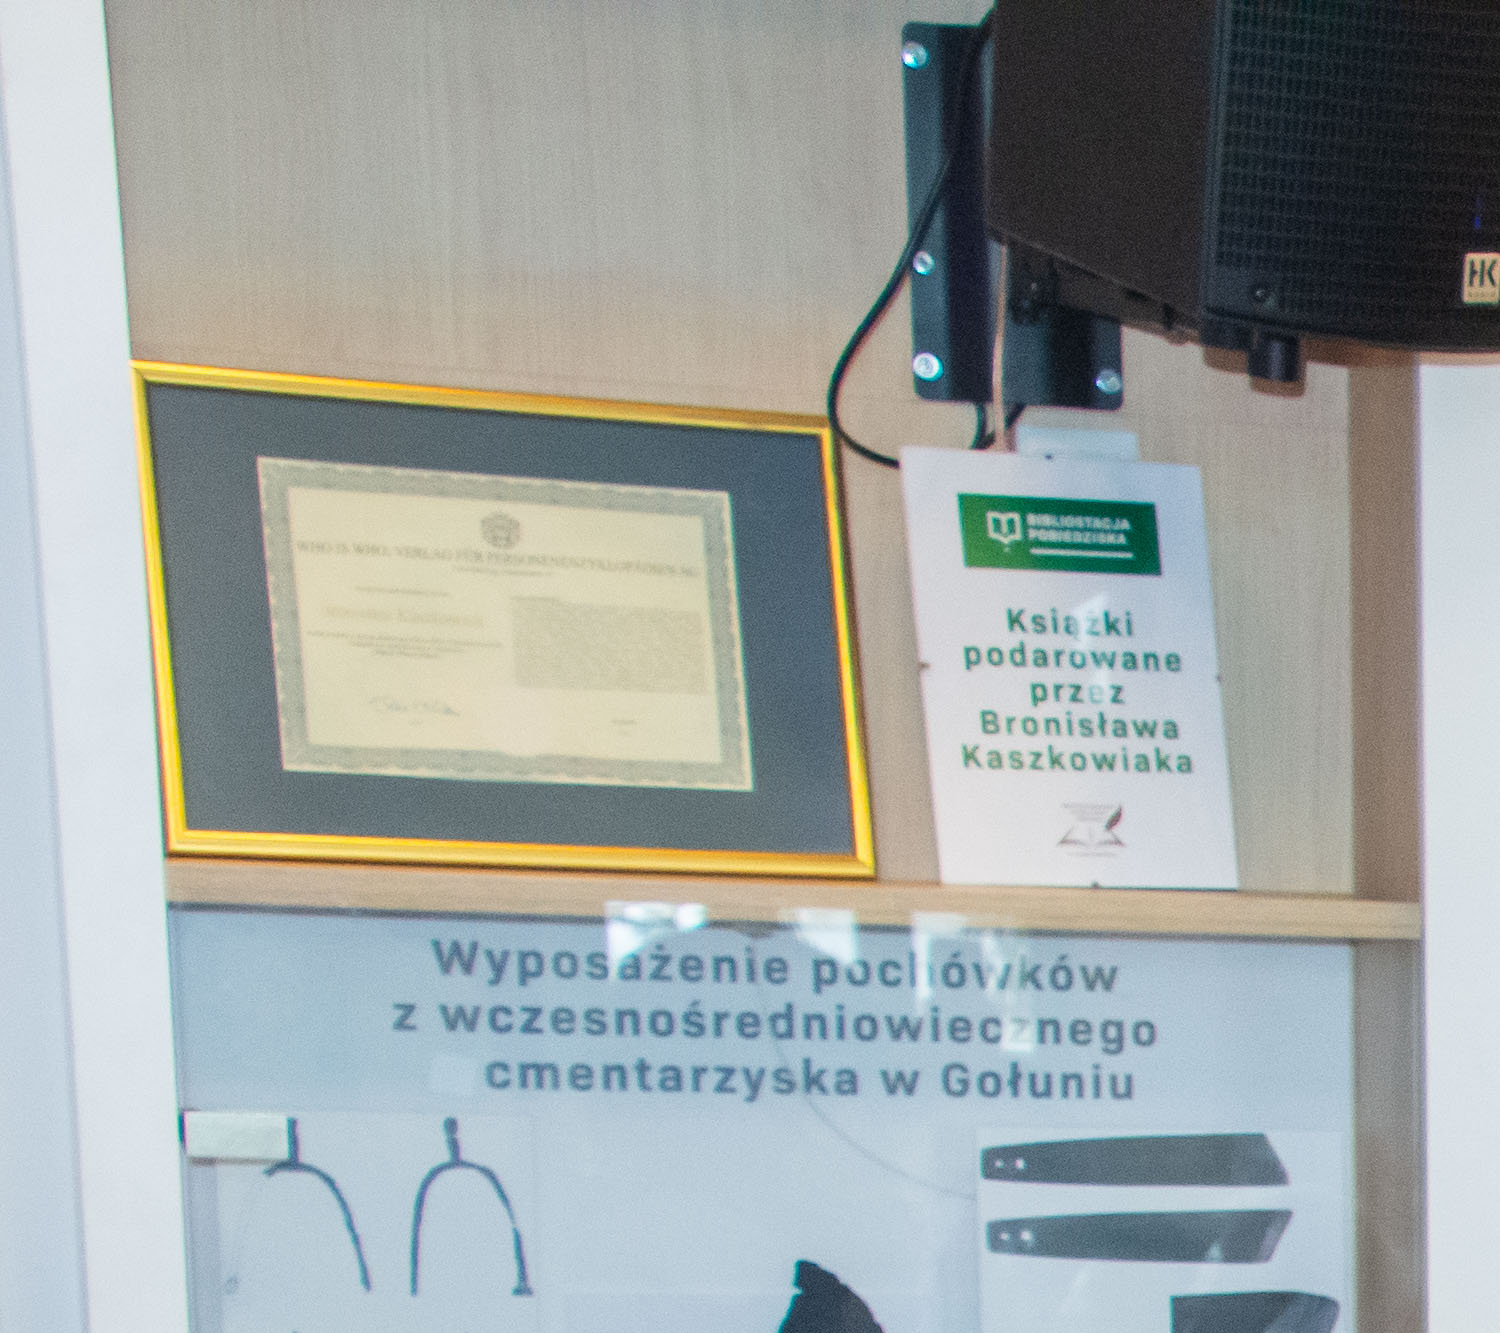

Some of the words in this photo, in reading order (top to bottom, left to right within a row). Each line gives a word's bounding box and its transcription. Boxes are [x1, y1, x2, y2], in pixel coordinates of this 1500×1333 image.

[1468, 259, 1497, 287] HK
[1006, 607, 1134, 640] Książki
[963, 642, 1183, 673] podarowane
[1030, 680, 1125, 708] przez
[979, 709, 1180, 741] Bronisława
[961, 744, 1194, 774] Kaszkowiaka
[431, 939, 790, 987] Wyposażenie
[392, 1000, 419, 1034] z
[440, 998, 1158, 1051] wczesnośredniowiecznego
[485, 1057, 860, 1103] cmentarzyska
[880, 1066, 922, 1098] w
[939, 1059, 1137, 1103] Gołuniu
